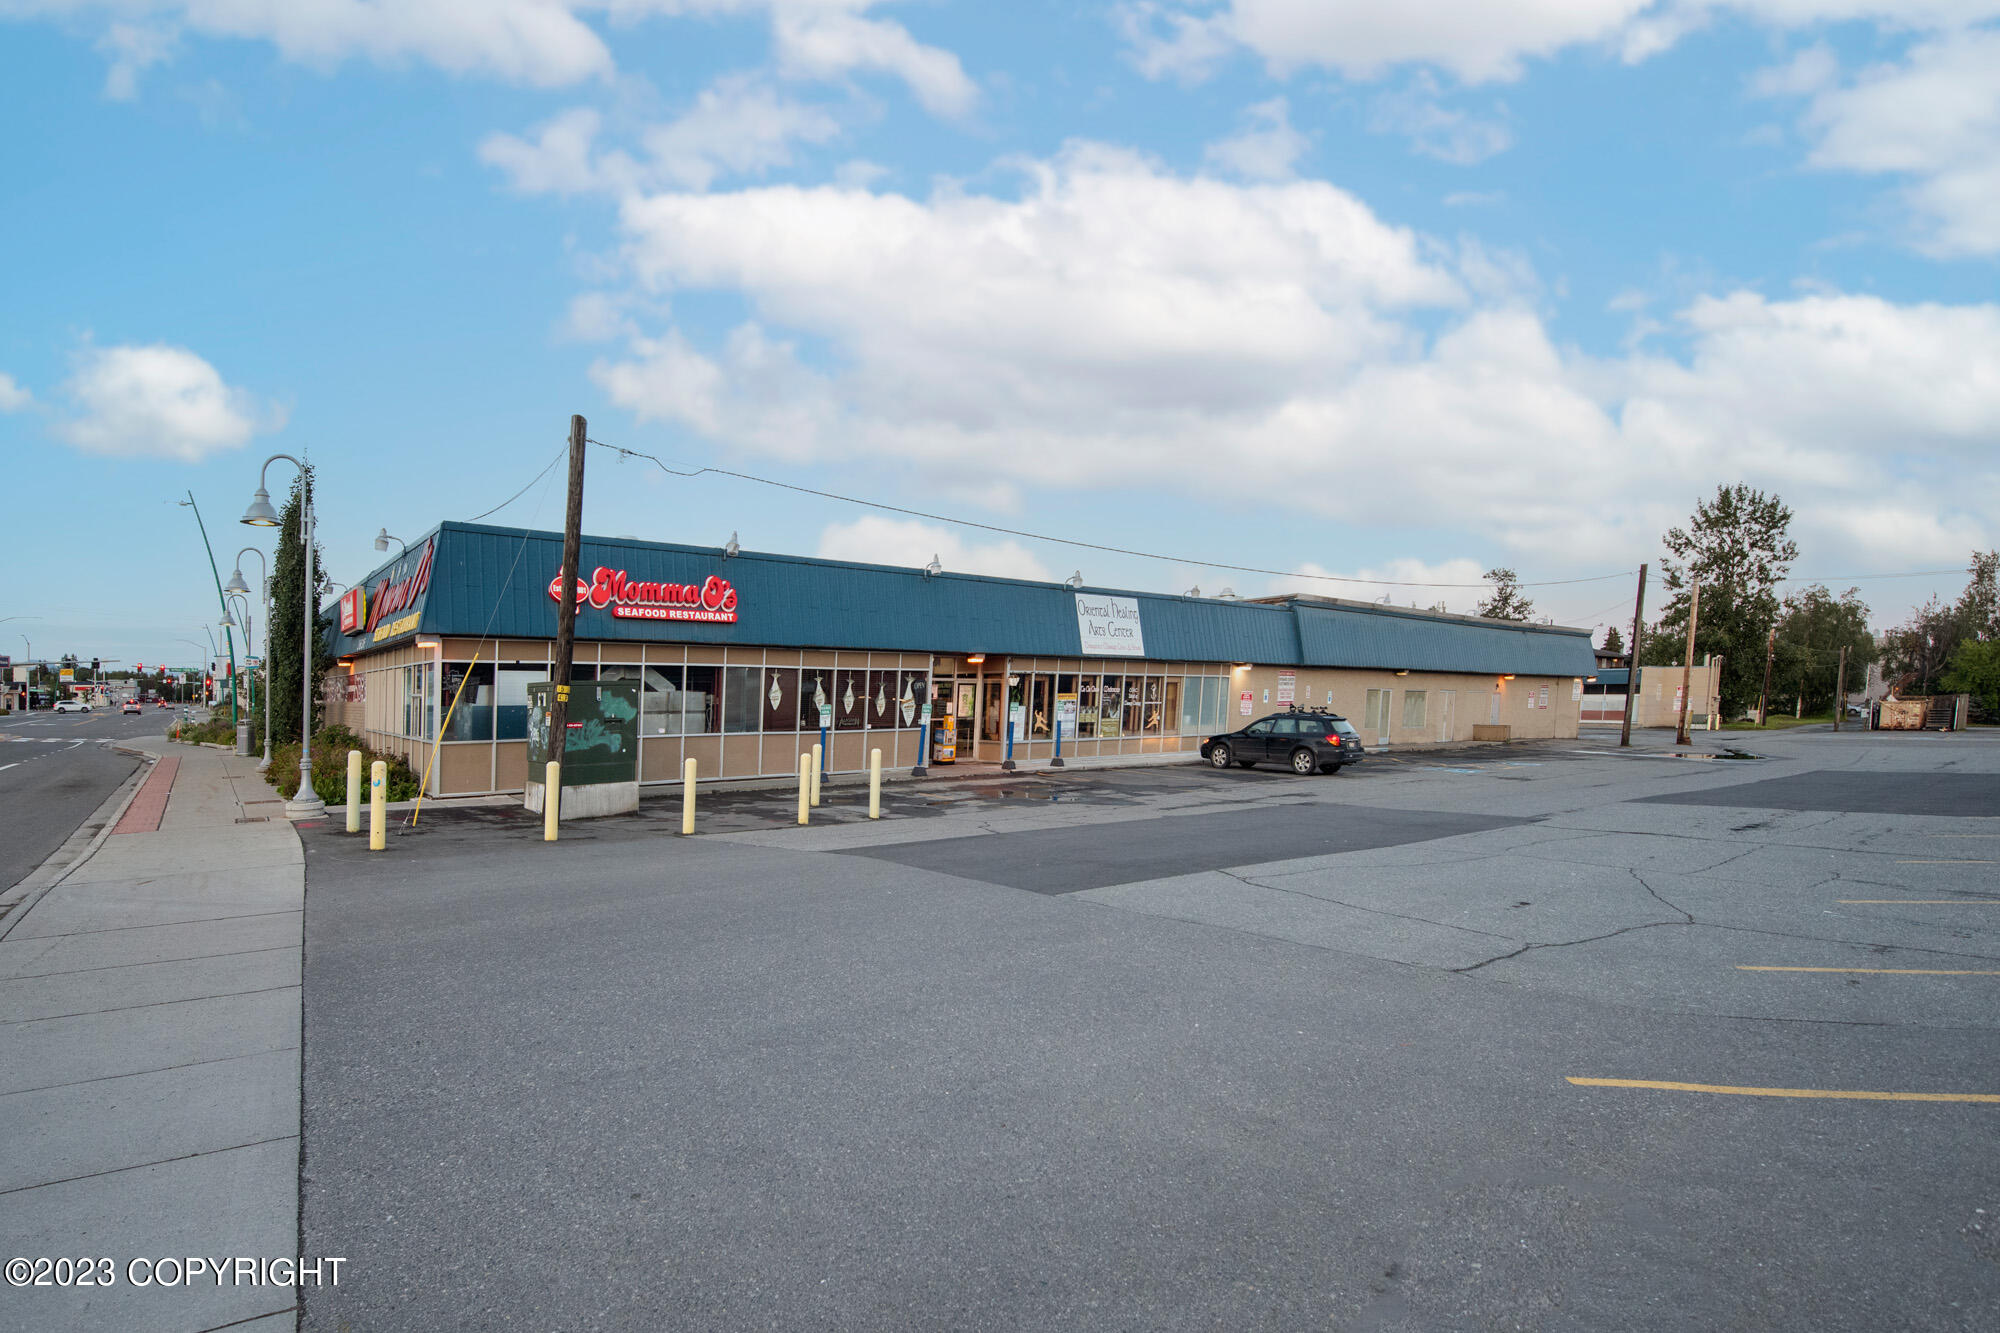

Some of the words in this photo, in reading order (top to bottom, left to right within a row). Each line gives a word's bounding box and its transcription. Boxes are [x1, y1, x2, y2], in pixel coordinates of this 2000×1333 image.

[589, 566, 701, 609] Momma
[701, 574, 738, 612] O's
[617, 607, 667, 618] SEAFOOD
[669, 610, 734, 621] RESTAURANT
